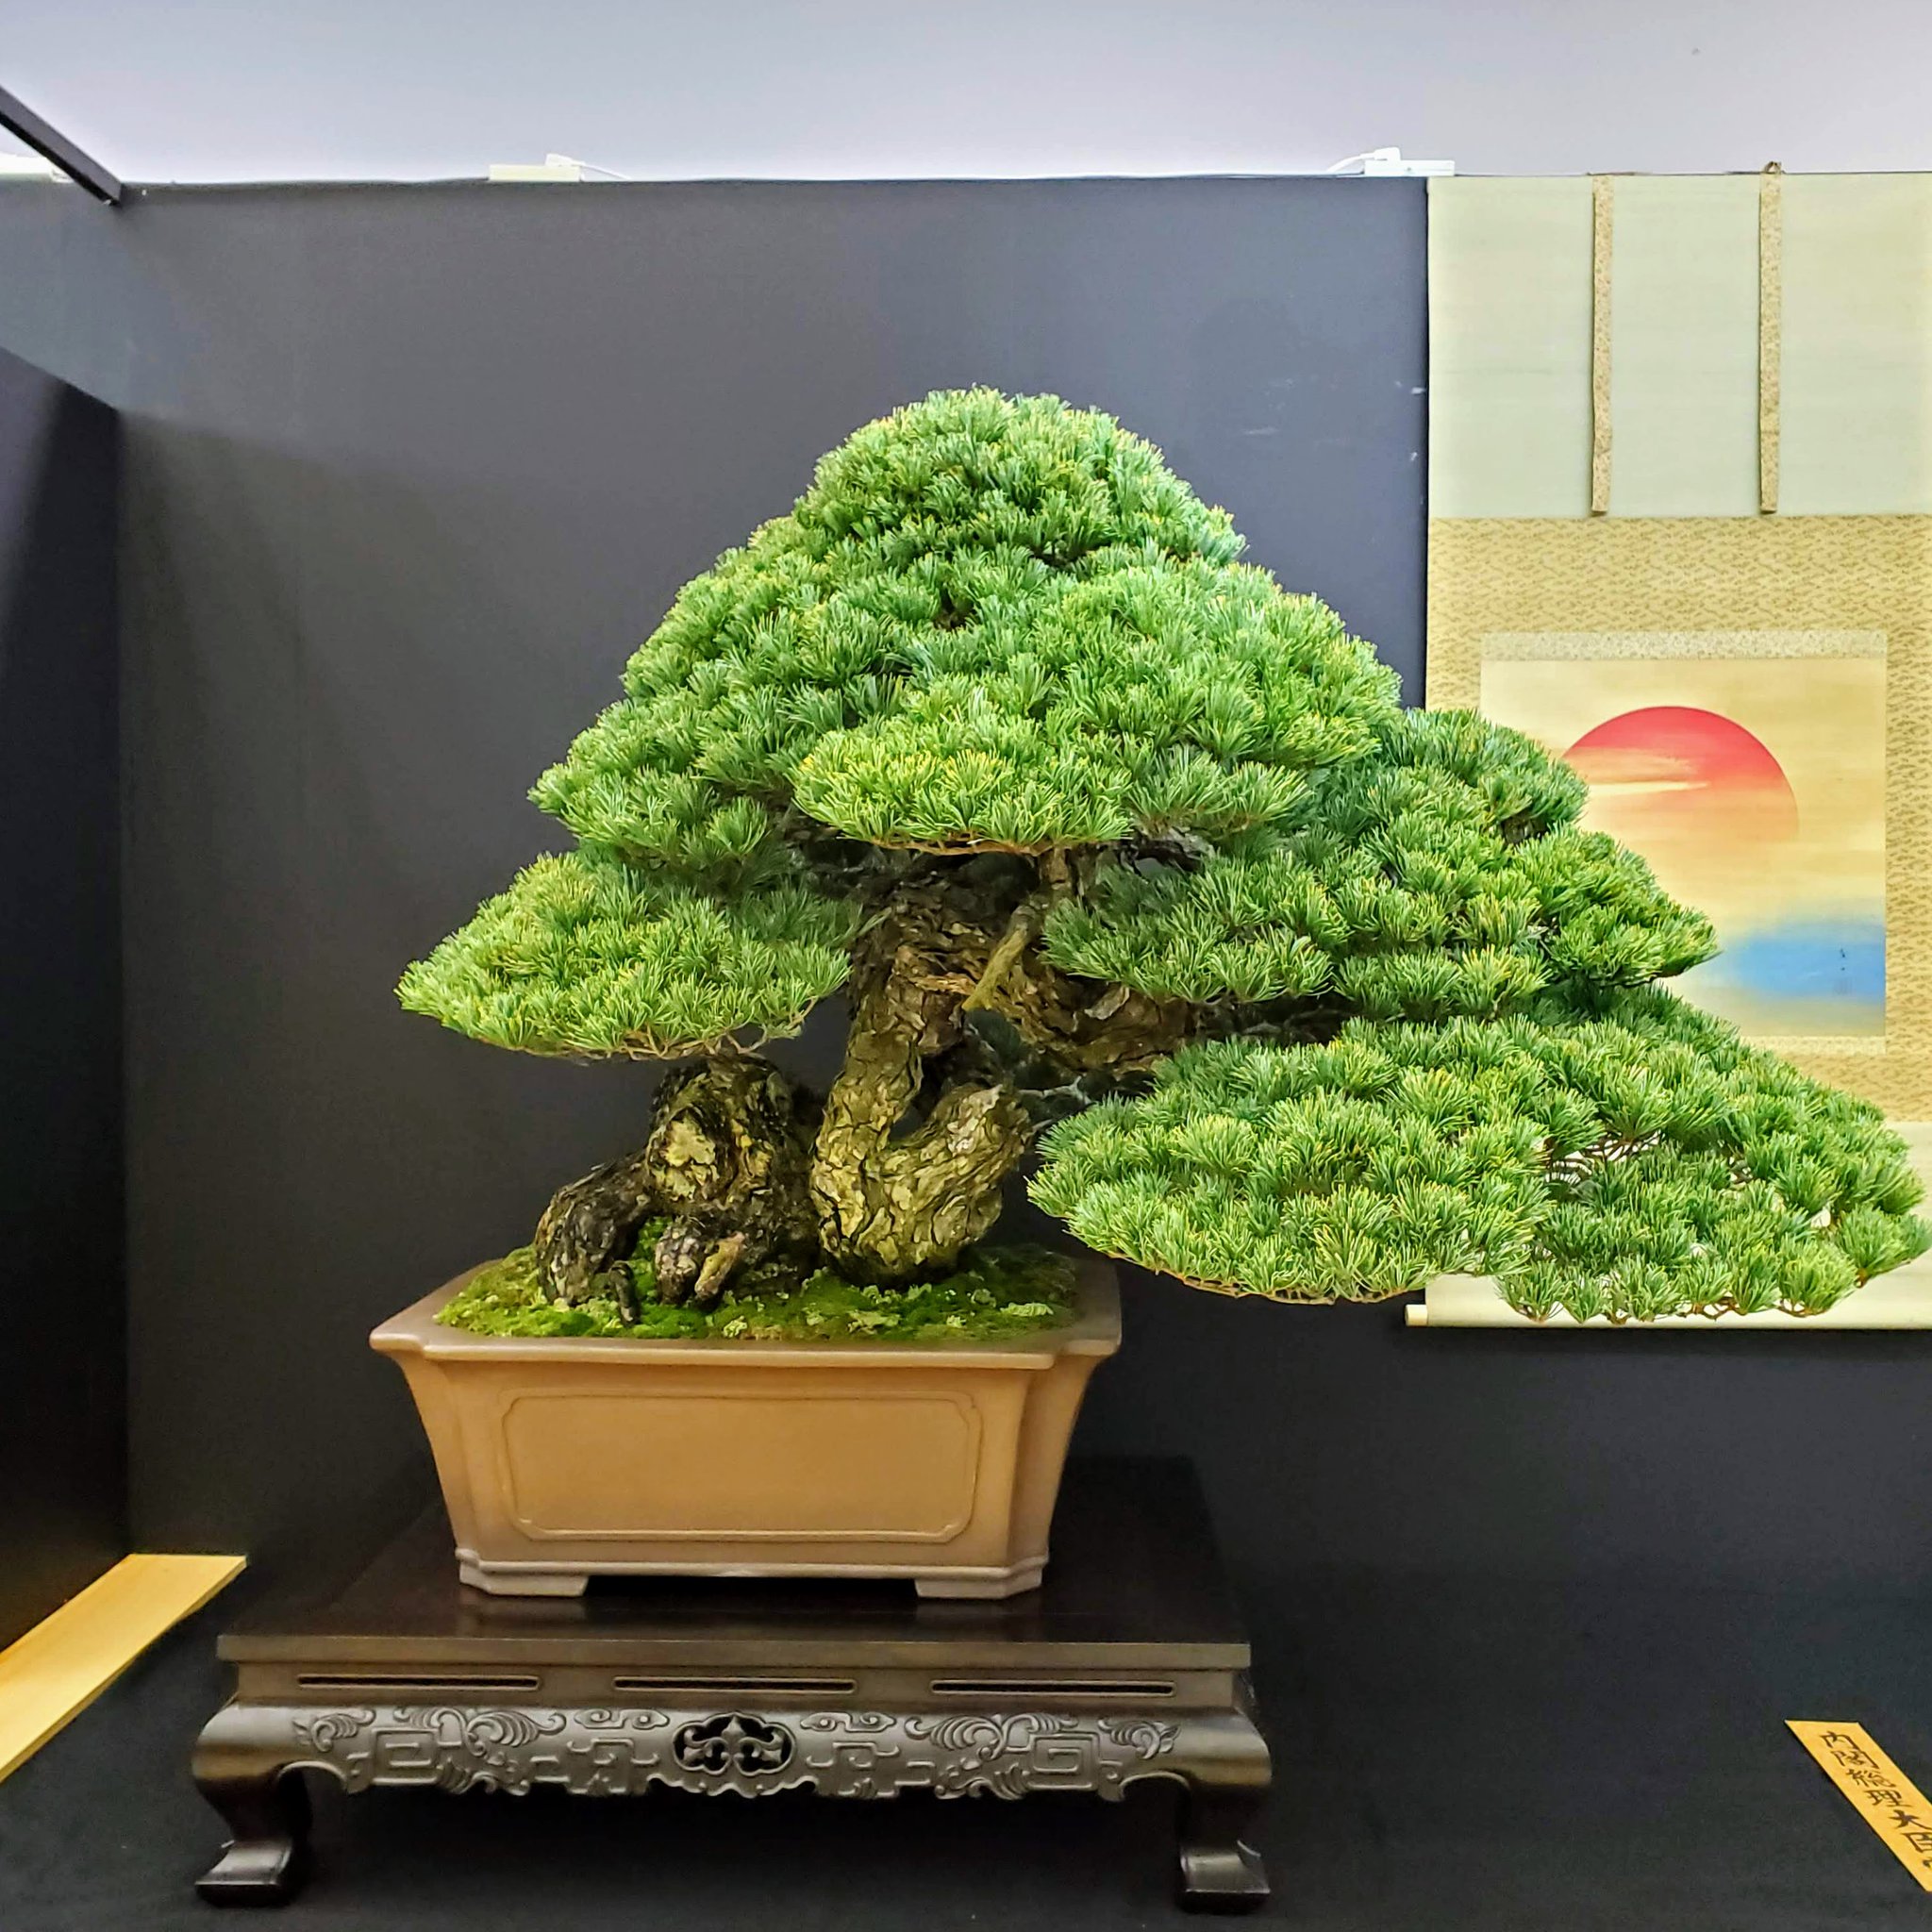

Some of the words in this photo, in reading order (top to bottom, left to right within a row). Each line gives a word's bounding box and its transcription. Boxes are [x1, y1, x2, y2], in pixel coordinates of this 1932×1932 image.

[1820, 1730, 1932, 1869] 内閣総理大臣
